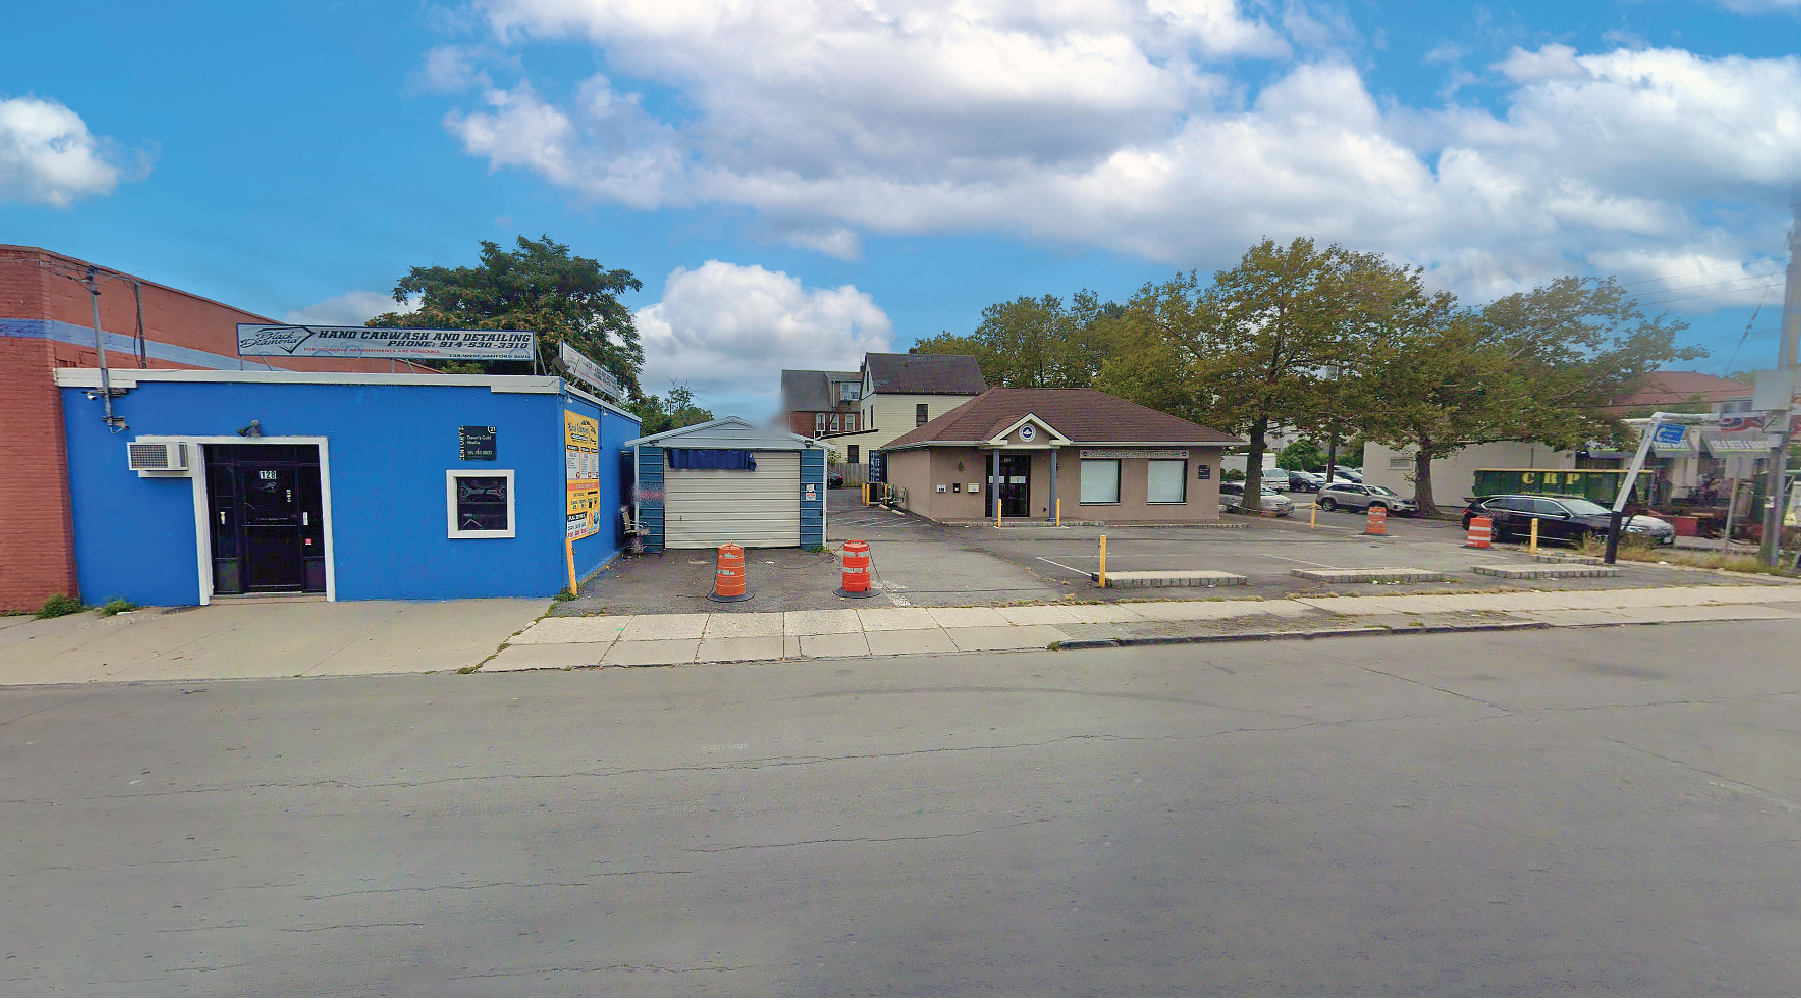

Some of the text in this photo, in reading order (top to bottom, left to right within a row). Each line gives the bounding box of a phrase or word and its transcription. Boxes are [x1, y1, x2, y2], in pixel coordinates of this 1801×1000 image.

[255, 331, 296, 341] Black
[318, 330, 532, 343] HAND CARWASH AND DETAILING
[240, 336, 301, 349] Diamond
[387, 340, 530, 349] PHONE: 914-530-3310
[261, 471, 276, 480] 128
